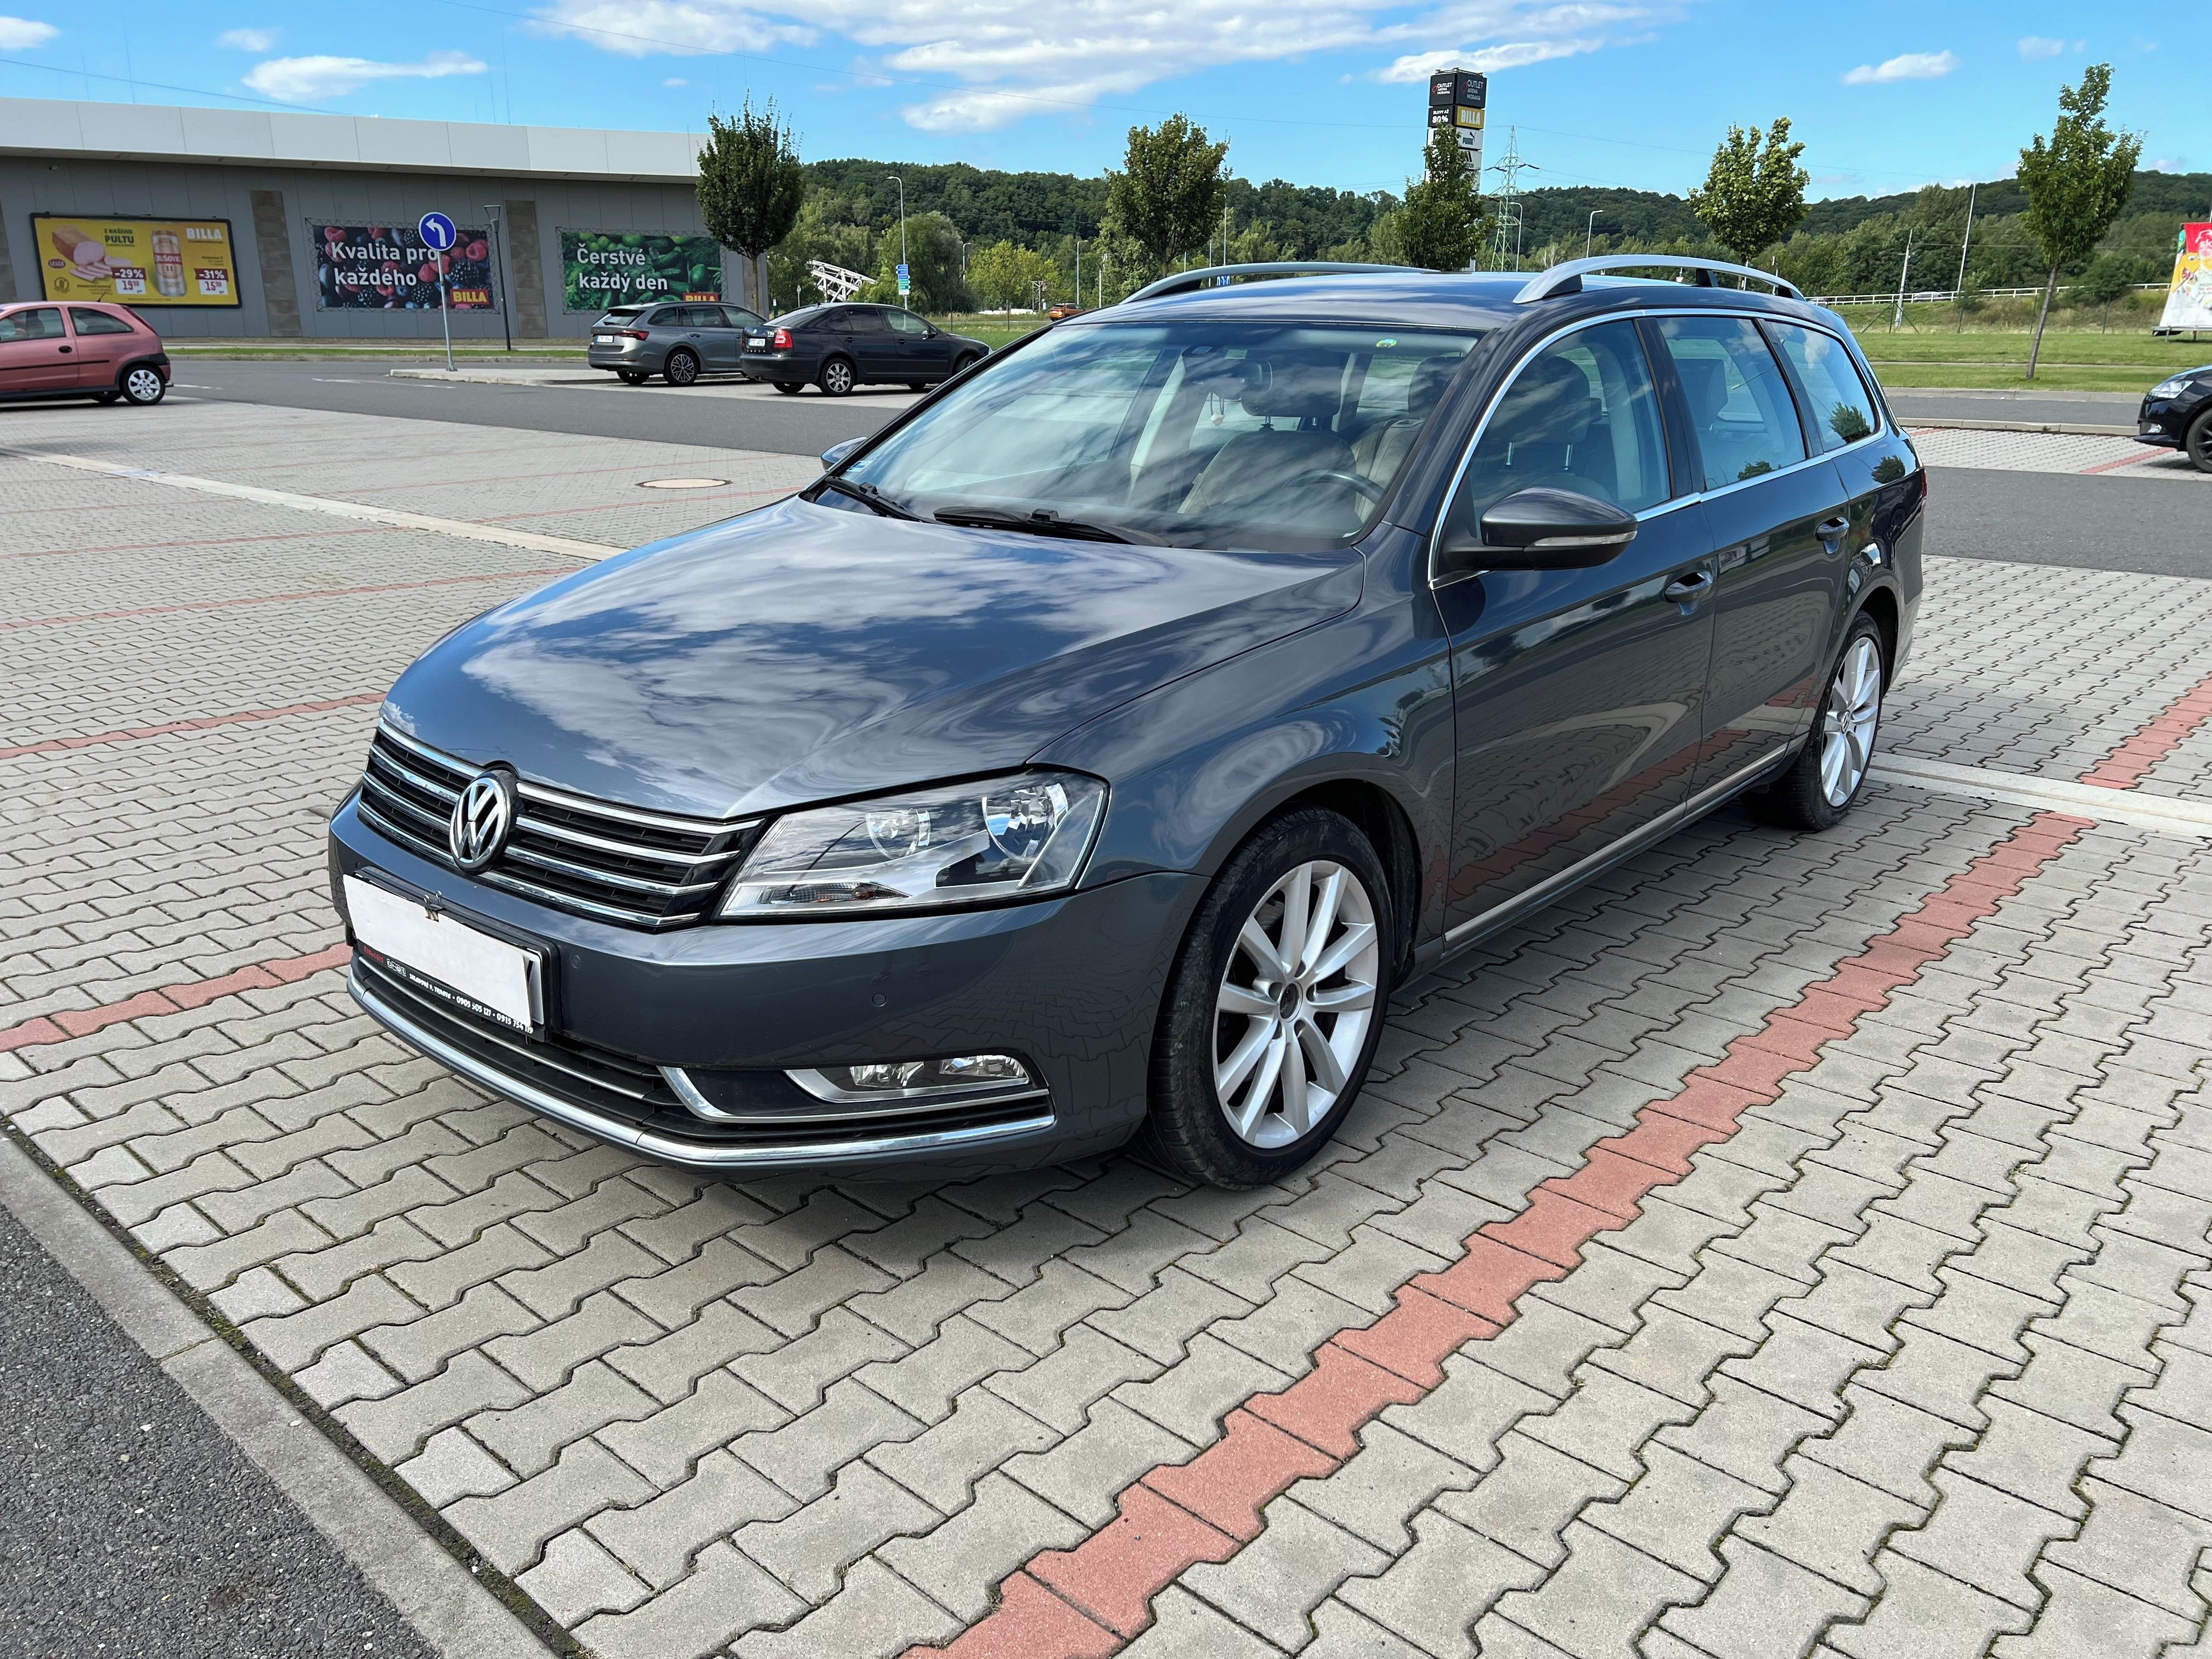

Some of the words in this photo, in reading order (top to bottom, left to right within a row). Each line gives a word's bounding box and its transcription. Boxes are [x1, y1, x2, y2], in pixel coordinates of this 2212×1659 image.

[1468, 80, 1483, 89] OUTLET
[1461, 110, 1480, 125] BILLA
[105, 235, 134, 243] PULTU
[186, 228, 222, 239] BILLA
[330, 242, 400, 261] Kvalita
[407, 249, 439, 264] pro
[577, 243, 646, 265] Čerstvé
[115, 269, 143, 278] -29%
[199, 270, 224, 279] -31%
[334, 268, 417, 286] každého
[579, 272, 630, 293] každý
[636, 274, 668, 291] den
[453, 291, 488, 302] BILLA
[456, 996, 471, 1008] 0905
[472, 1002, 482, 1013] 505
[496, 1013, 511, 1025] 0915
[513, 1019, 523, 1030] 754
